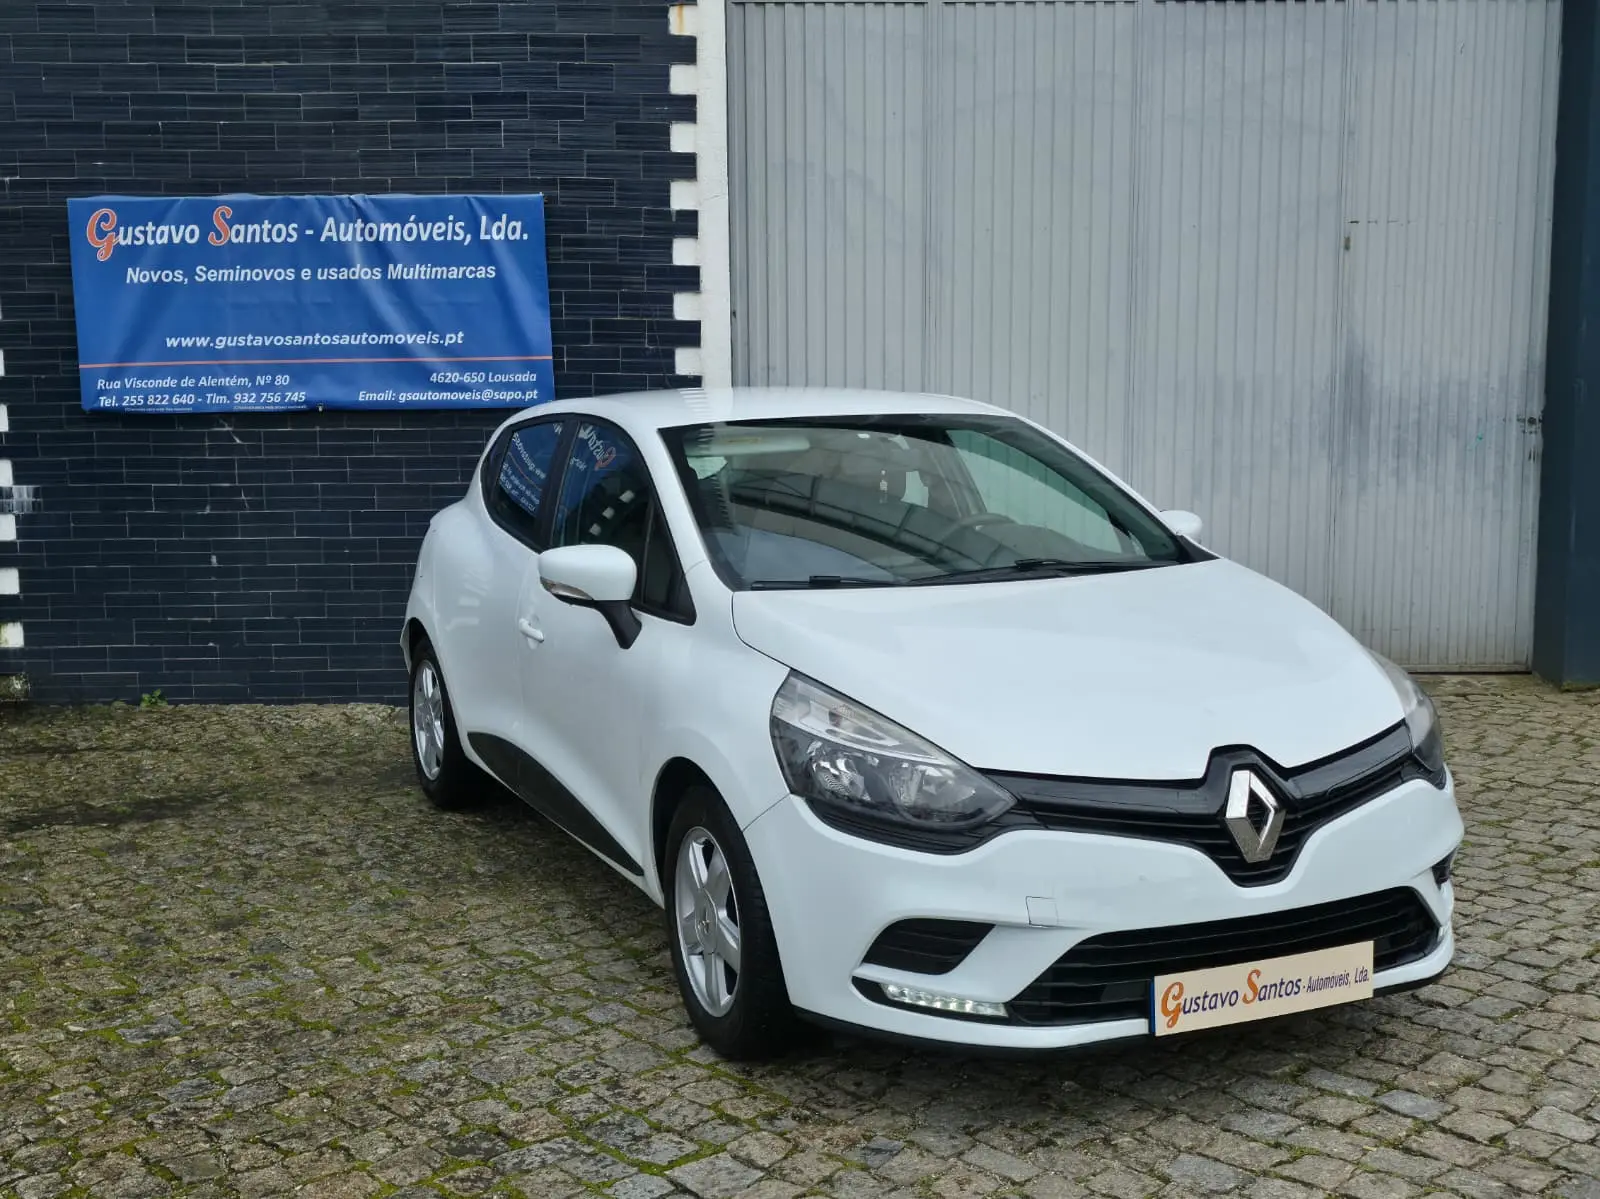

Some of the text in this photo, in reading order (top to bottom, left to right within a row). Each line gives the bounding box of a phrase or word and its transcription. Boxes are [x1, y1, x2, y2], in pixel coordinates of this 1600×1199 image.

[86, 208, 200, 262] Gustavo
[207, 205, 298, 247] Santos
[320, 214, 472, 246] Automóveis,
[479, 213, 529, 241] Lda.
[126, 263, 496, 285] Novos, Seminovos e usados Multimarcas
[165, 331, 465, 349] www.gustavosantosautomoveis.pt
[97, 379, 121, 390] Rua
[124, 376, 178, 389] Visconde
[180, 376, 196, 387] de
[197, 374, 253, 388] Alentém,
[274, 374, 290, 386] 80
[429, 371, 537, 383] 4620-650 Lousada
[98, 395, 119, 407] Tel.
[121, 395, 144, 406] 255
[146, 394, 169, 405] 822
[172, 393, 195, 405] 640
[205, 392, 230, 404] Tlm.
[233, 392, 256, 403] 932
[260, 392, 281, 403] 756
[284, 391, 306, 403] 745
[358, 388, 538, 403] Email: gsautomoveis@sapo.pt
[1160, 981, 1239, 1028] Gustavo
[1241, 969, 1302, 1005] Santos
[1354, 965, 1370, 984] Lda.
